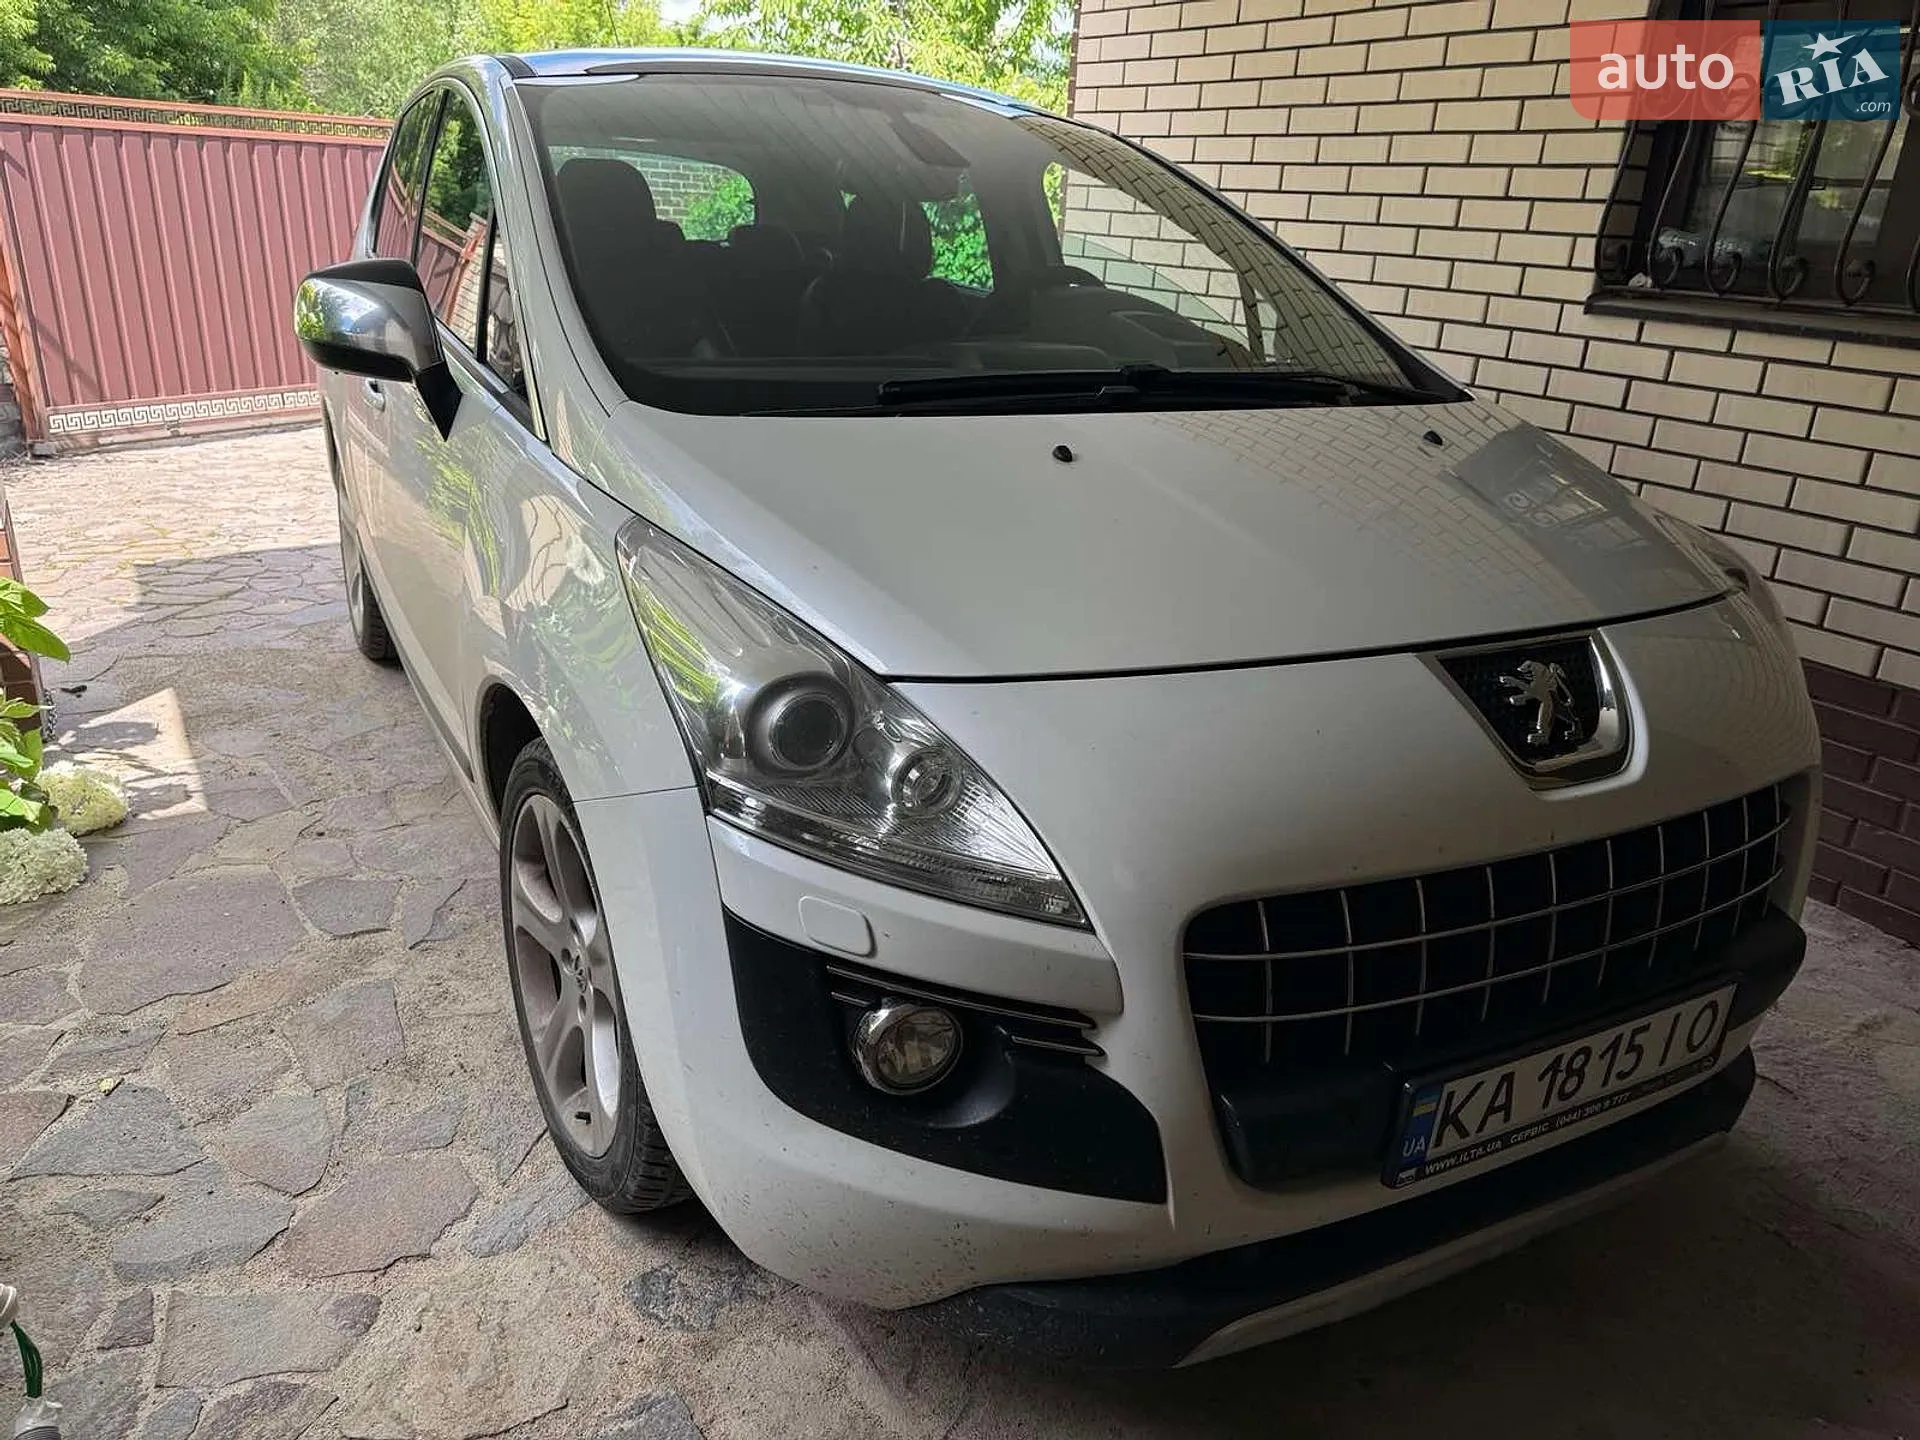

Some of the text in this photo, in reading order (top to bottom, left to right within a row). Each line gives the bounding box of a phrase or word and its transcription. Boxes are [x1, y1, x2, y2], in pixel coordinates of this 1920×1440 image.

[1434, 999, 1718, 1147] KA 1815 IO
[1402, 1136, 1426, 1158] UA
